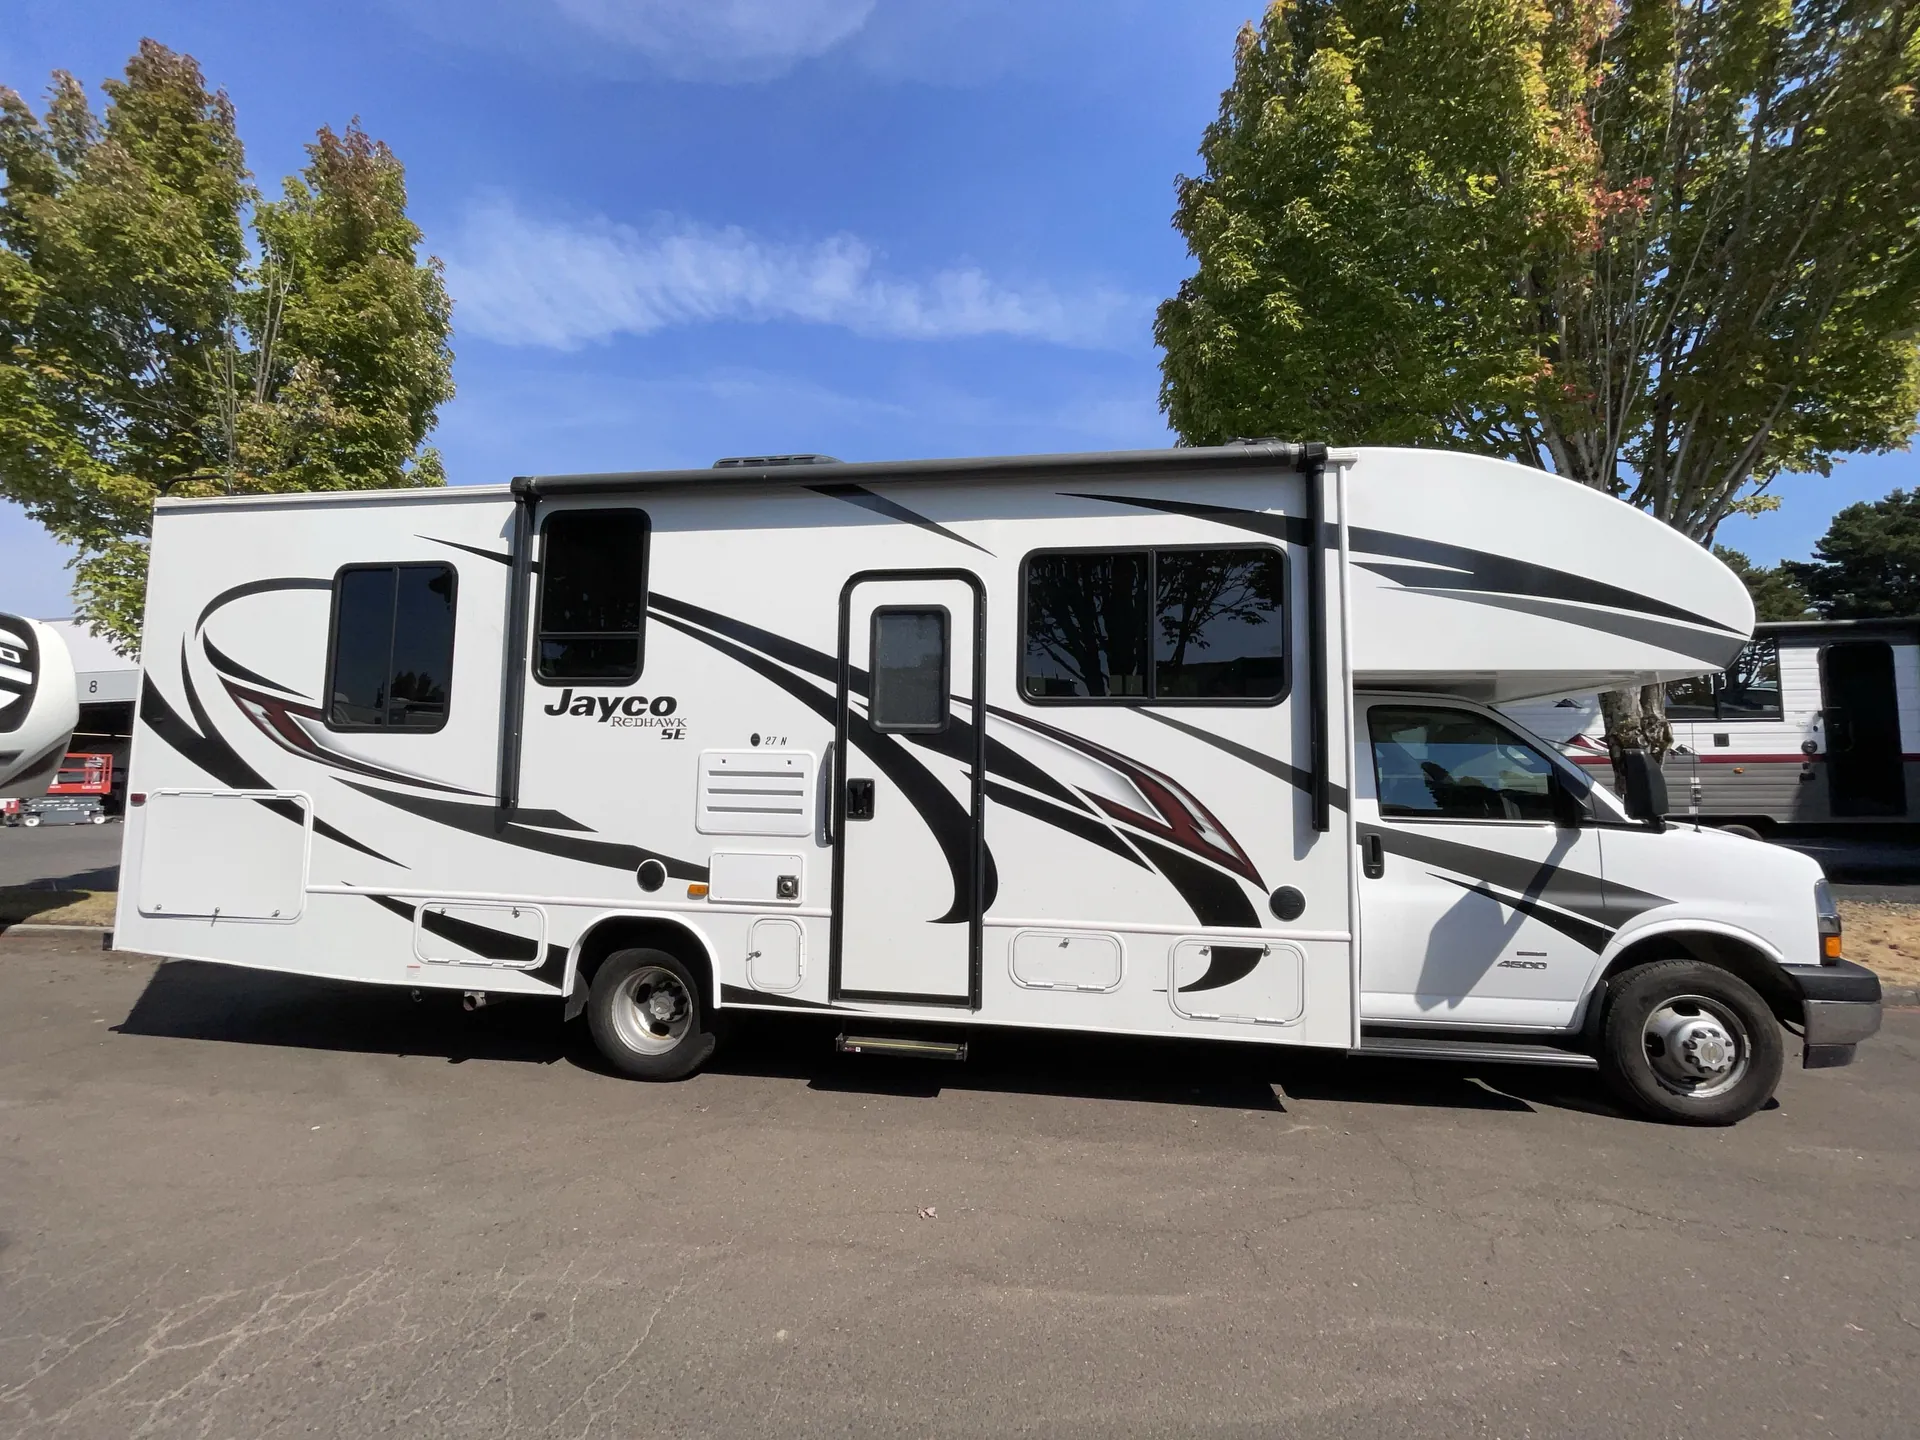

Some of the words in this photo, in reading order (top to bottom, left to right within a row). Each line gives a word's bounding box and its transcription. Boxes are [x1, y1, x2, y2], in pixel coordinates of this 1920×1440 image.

[89, 680, 98, 693] 8
[544, 688, 677, 723] Jayco
[661, 728, 687, 740] SE
[765, 736, 777, 745] 27
[781, 737, 788, 745] N
[1497, 960, 1547, 970] 4500
